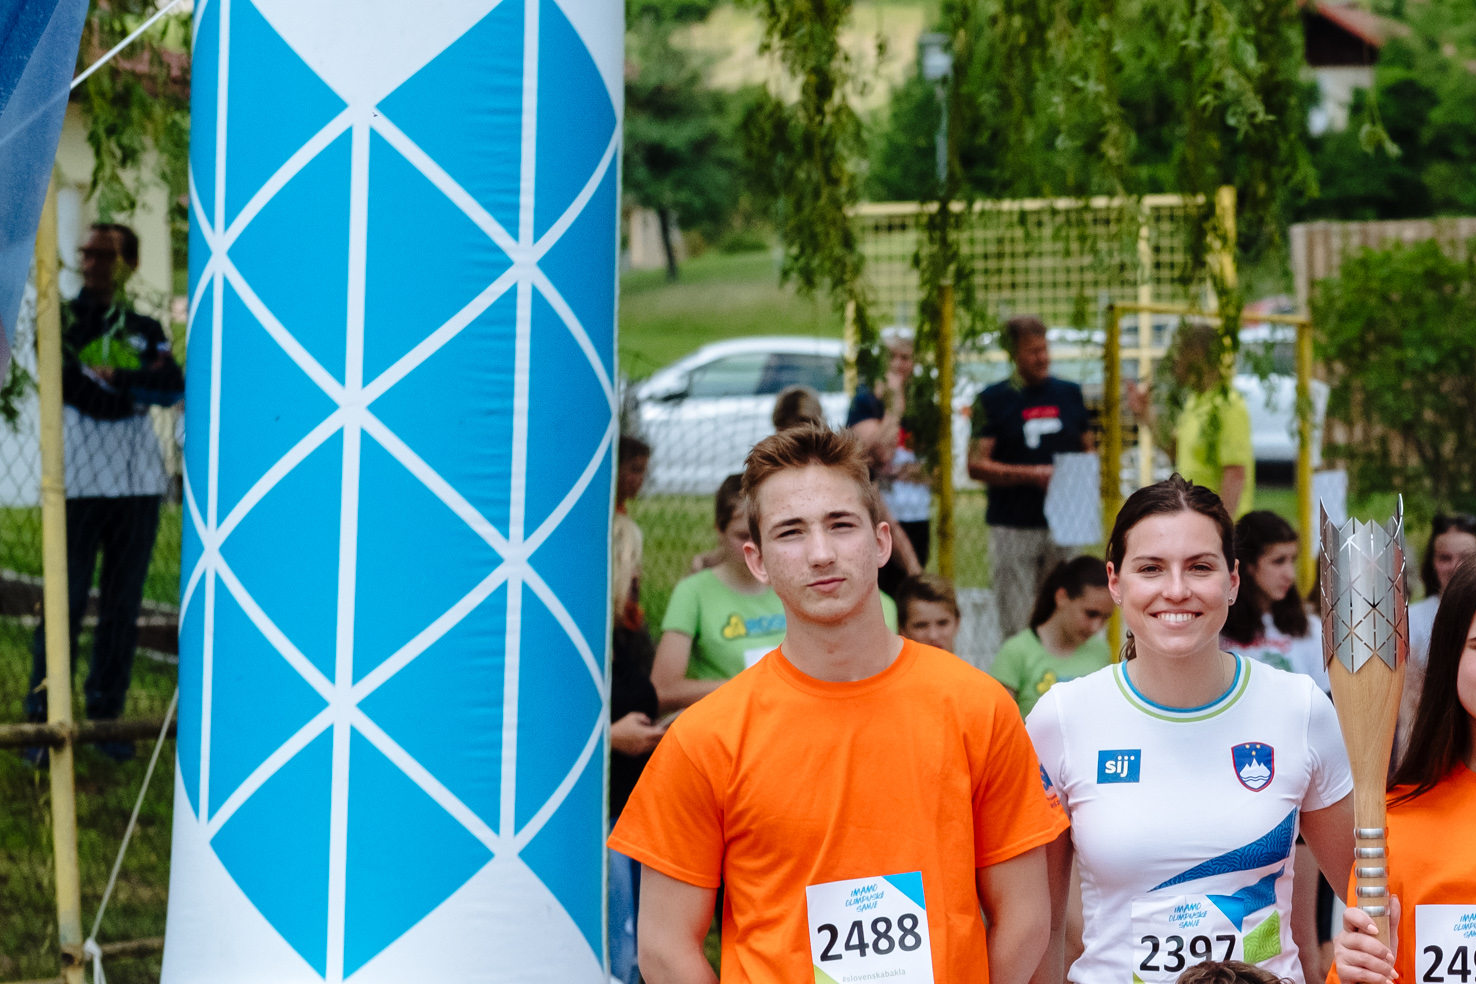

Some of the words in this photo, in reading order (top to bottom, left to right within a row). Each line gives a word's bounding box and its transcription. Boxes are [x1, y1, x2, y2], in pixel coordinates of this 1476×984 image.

[1105, 754, 1135, 778] sij
[850, 883, 878, 898] IMAMO
[1174, 902, 1202, 914] IMAMO
[817, 912, 922, 963] 2488
[1139, 934, 1236, 972] 2397
[842, 968, 906, 983] #slovenskabakla
